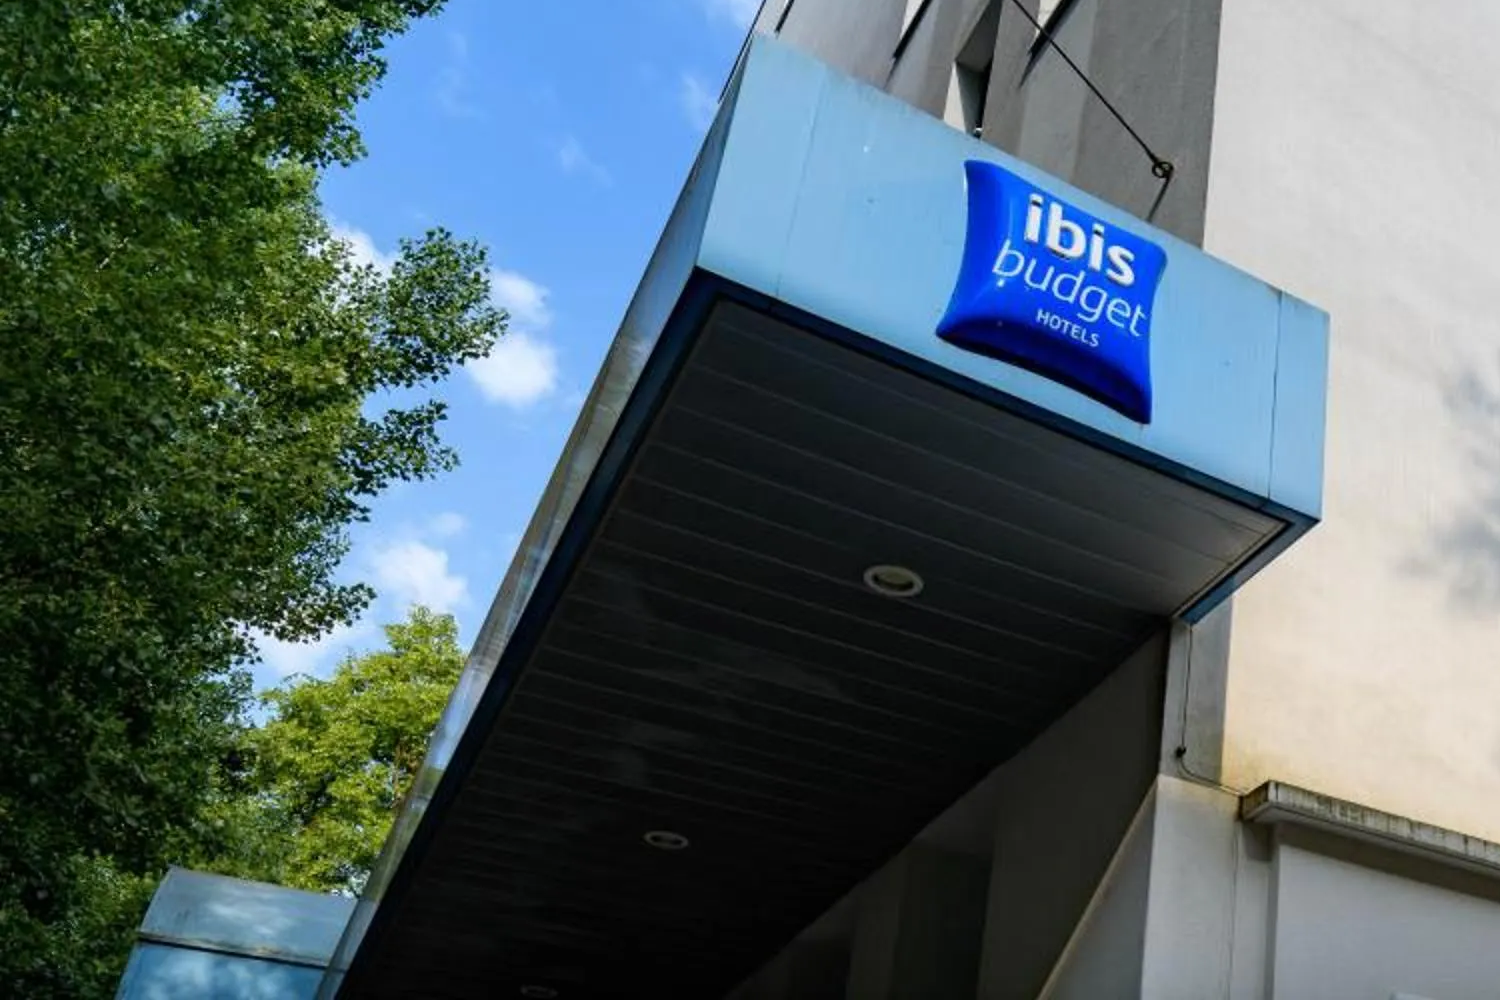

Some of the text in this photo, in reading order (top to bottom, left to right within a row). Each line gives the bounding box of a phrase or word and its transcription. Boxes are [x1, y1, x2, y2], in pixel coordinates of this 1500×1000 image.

[1024, 193, 1135, 287] ibis
[992, 239, 1147, 337] budget
[1035, 308, 1100, 348] HOTELS
